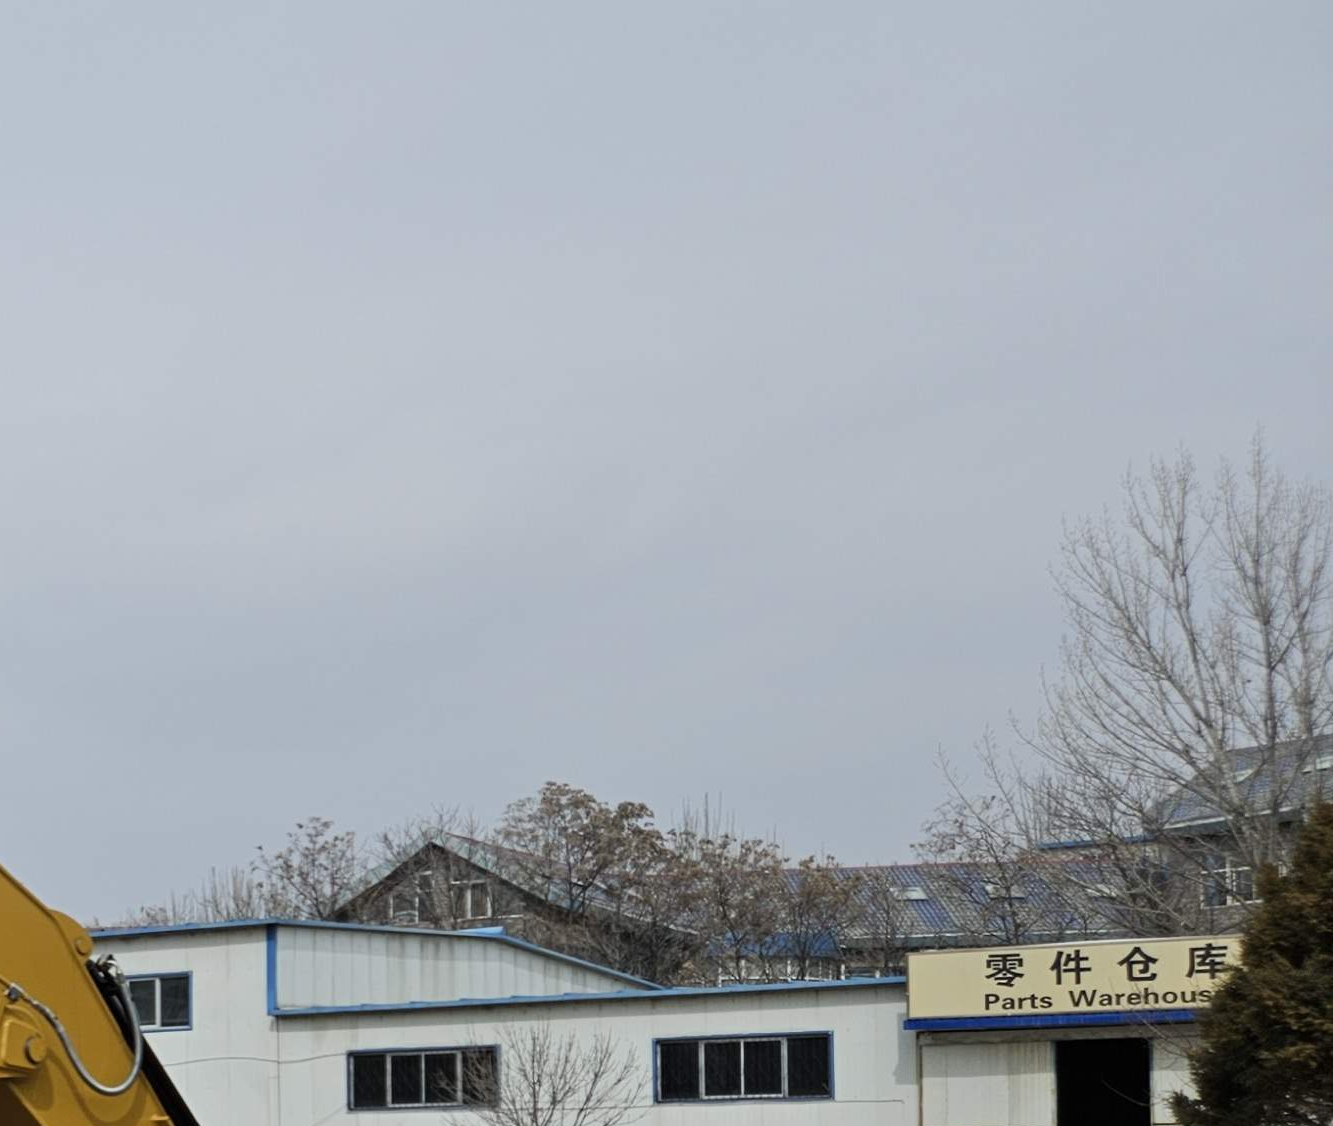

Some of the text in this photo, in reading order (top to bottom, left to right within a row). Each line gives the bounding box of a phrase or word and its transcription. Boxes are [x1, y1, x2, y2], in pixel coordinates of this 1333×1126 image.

[985, 943, 1228, 987] 零件仓库
[984, 987, 1214, 1010] Parts Warehous
